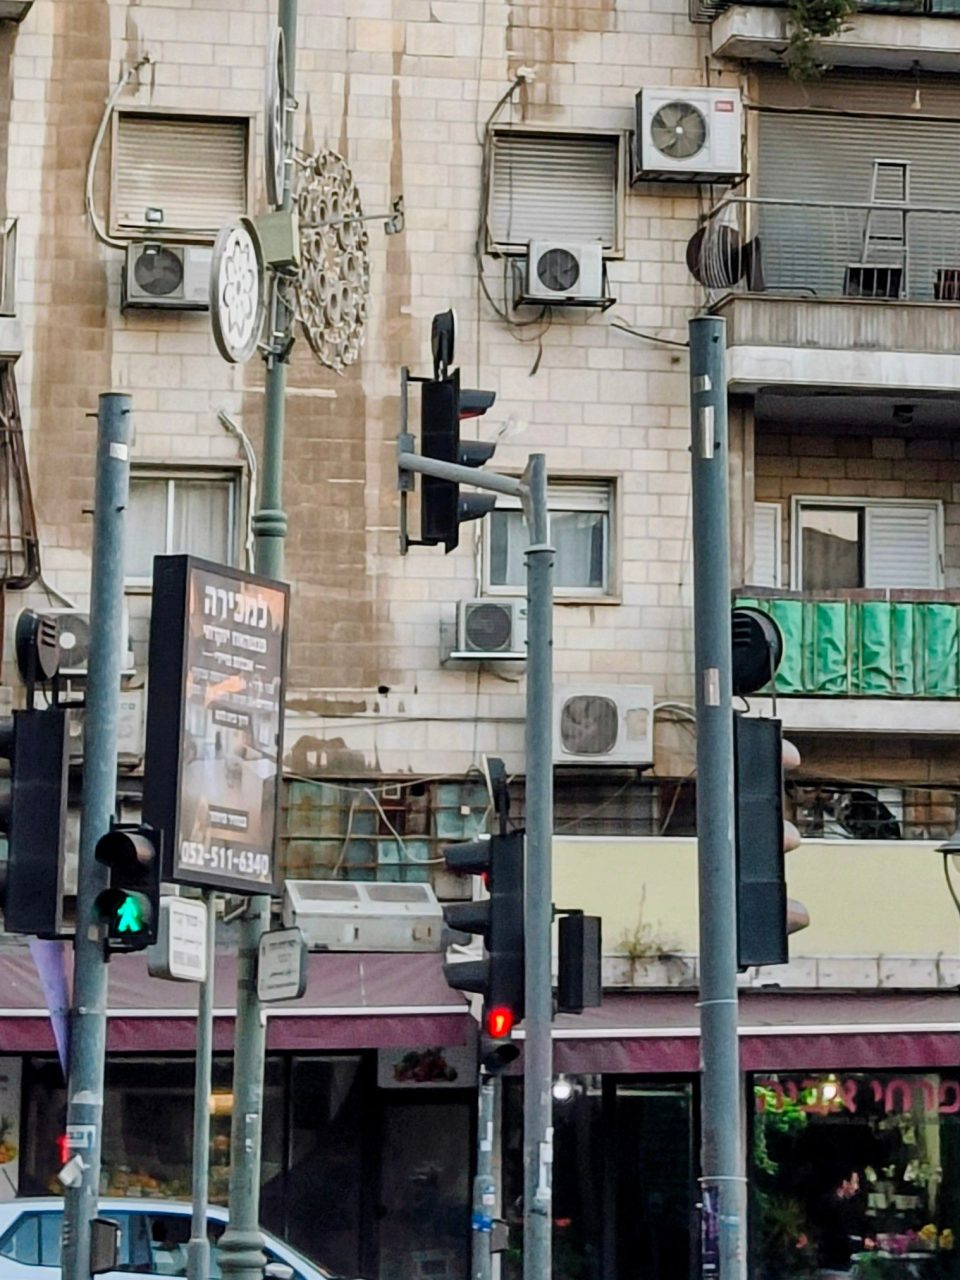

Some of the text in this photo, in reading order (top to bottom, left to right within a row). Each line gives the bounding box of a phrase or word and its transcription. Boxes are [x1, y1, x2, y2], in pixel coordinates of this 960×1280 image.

[204, 586, 268, 628] למכירה
[181, 841, 269, 876] 052-511-6340
[871, 1079, 960, 1114] פרחי
